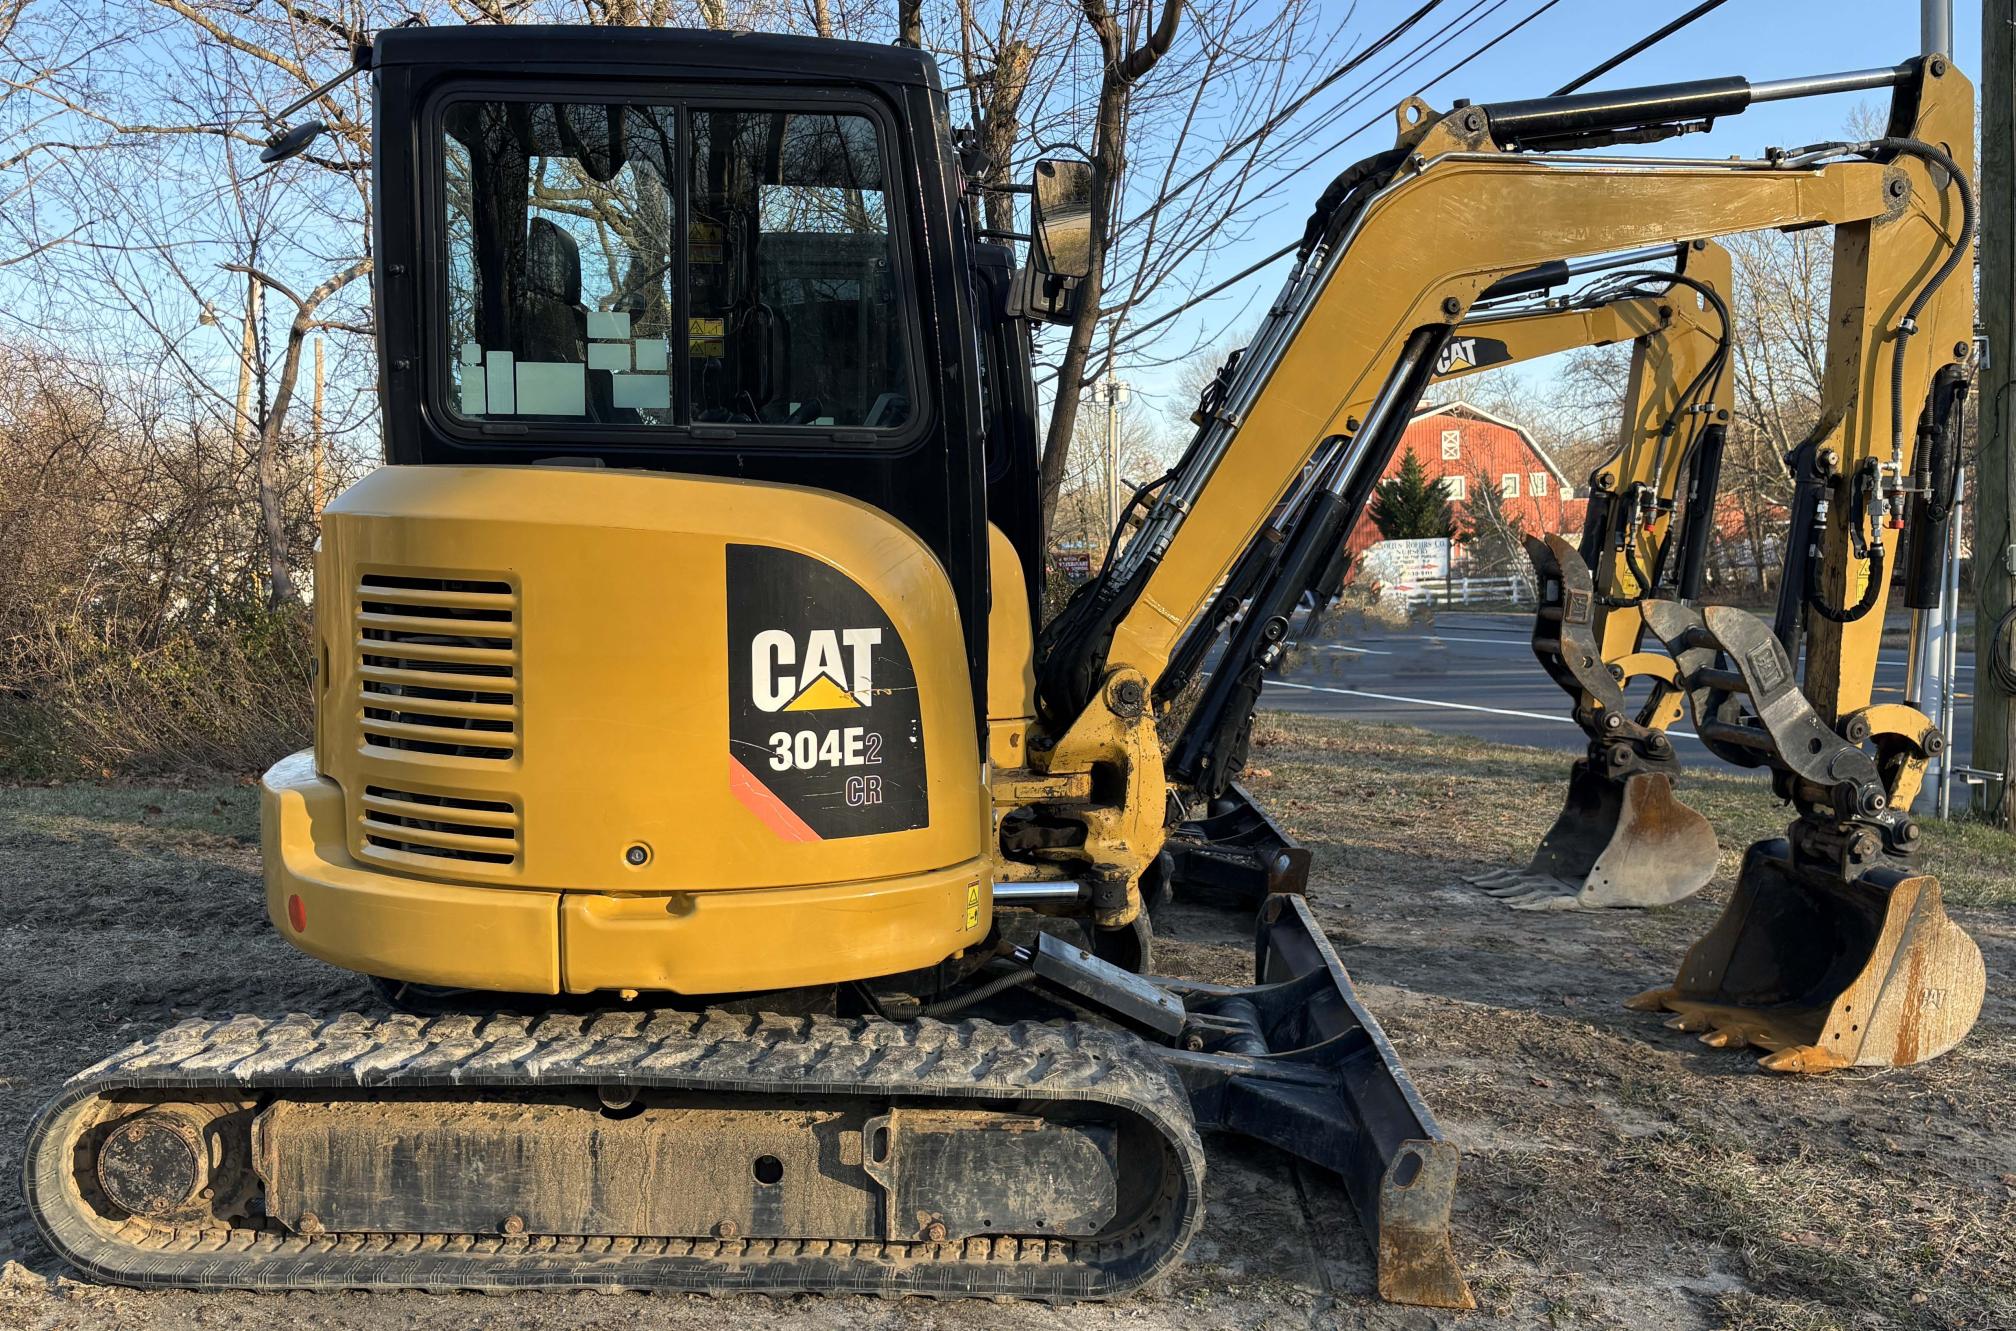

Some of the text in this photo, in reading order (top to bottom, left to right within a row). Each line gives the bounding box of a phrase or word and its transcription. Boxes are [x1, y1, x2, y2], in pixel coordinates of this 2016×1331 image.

[1437, 339, 1476, 373] CAT
[751, 627, 882, 713] CAT
[768, 726, 883, 772] 304E2
[845, 775, 883, 807] CR
